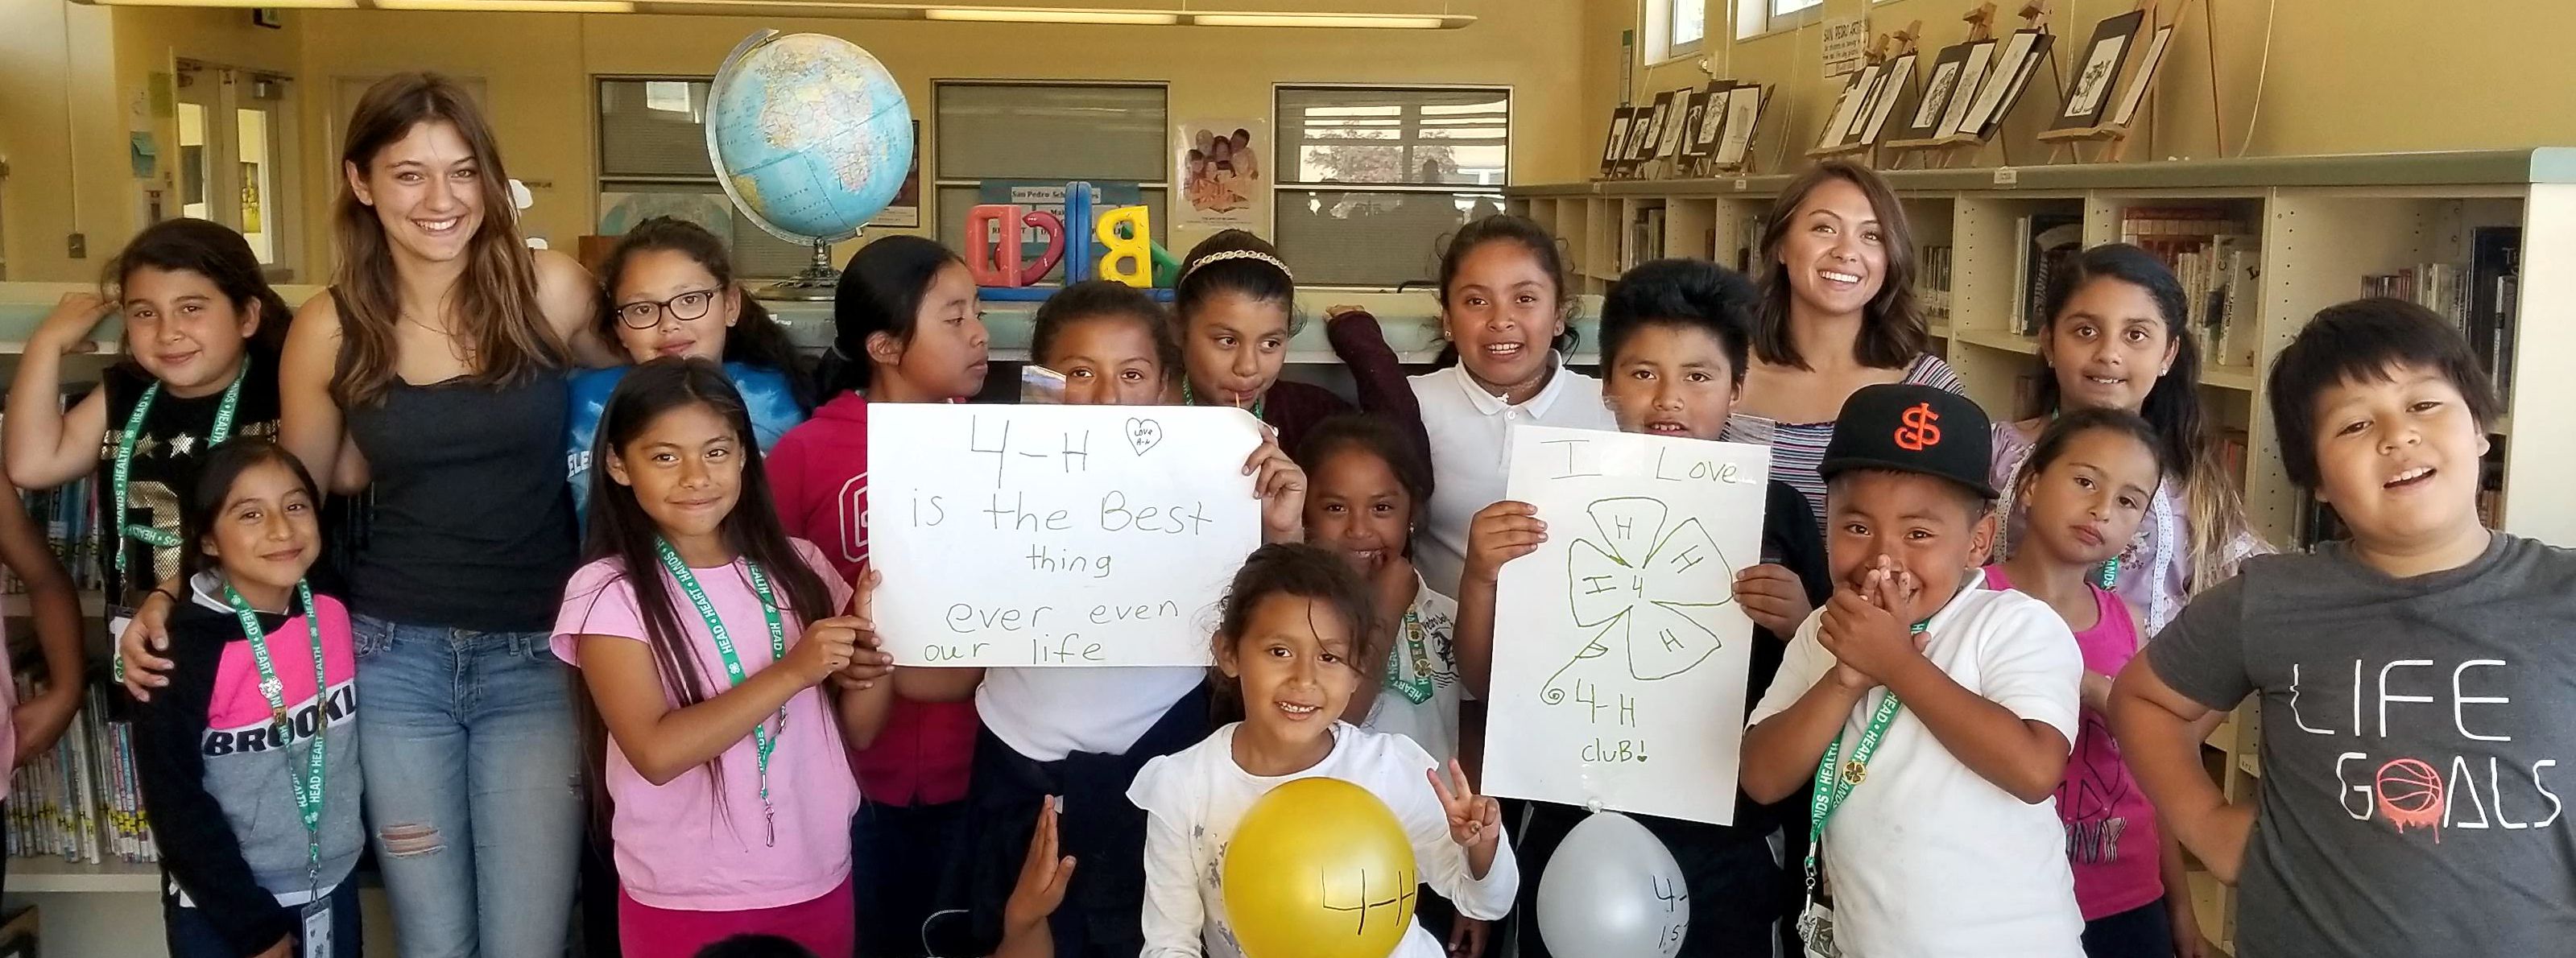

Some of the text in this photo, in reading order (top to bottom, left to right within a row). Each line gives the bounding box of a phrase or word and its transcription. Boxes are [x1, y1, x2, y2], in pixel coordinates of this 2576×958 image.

[1012, 190, 1026, 198] San
[131, 402, 150, 423] HEAD
[212, 410, 232, 443] HEALTH
[114, 446, 130, 482] HEALTH
[971, 415, 1089, 489] 4-H
[1540, 440, 1737, 484] I Love
[914, 488, 944, 527] is
[983, 491, 1074, 532] the
[1102, 490, 1213, 535] Best
[1615, 514, 1632, 540] H
[1025, 543, 1111, 578] thing
[303, 590, 316, 618] HEAD
[663, 551, 734, 654] HEAD HEART HANDS
[1632, 575, 1644, 599] 4
[946, 599, 1179, 634] ever even
[240, 608, 273, 675] HEAD HEART
[769, 621, 783, 651] HEAD
[924, 633, 1106, 664] our life
[1659, 628, 1685, 652] H
[312, 646, 324, 683] HEALTH
[1393, 679, 1423, 702] HEART
[1576, 678, 1635, 728] 4-H
[2289, 659, 2512, 741] LIFE
[1854, 692, 1898, 763] HEAD HEAR
[312, 737, 324, 766] HEART
[308, 775, 322, 803] HEAD
[1812, 742, 1840, 826] ANDS HEALTH
[1321, 866, 1416, 935] 4-H
